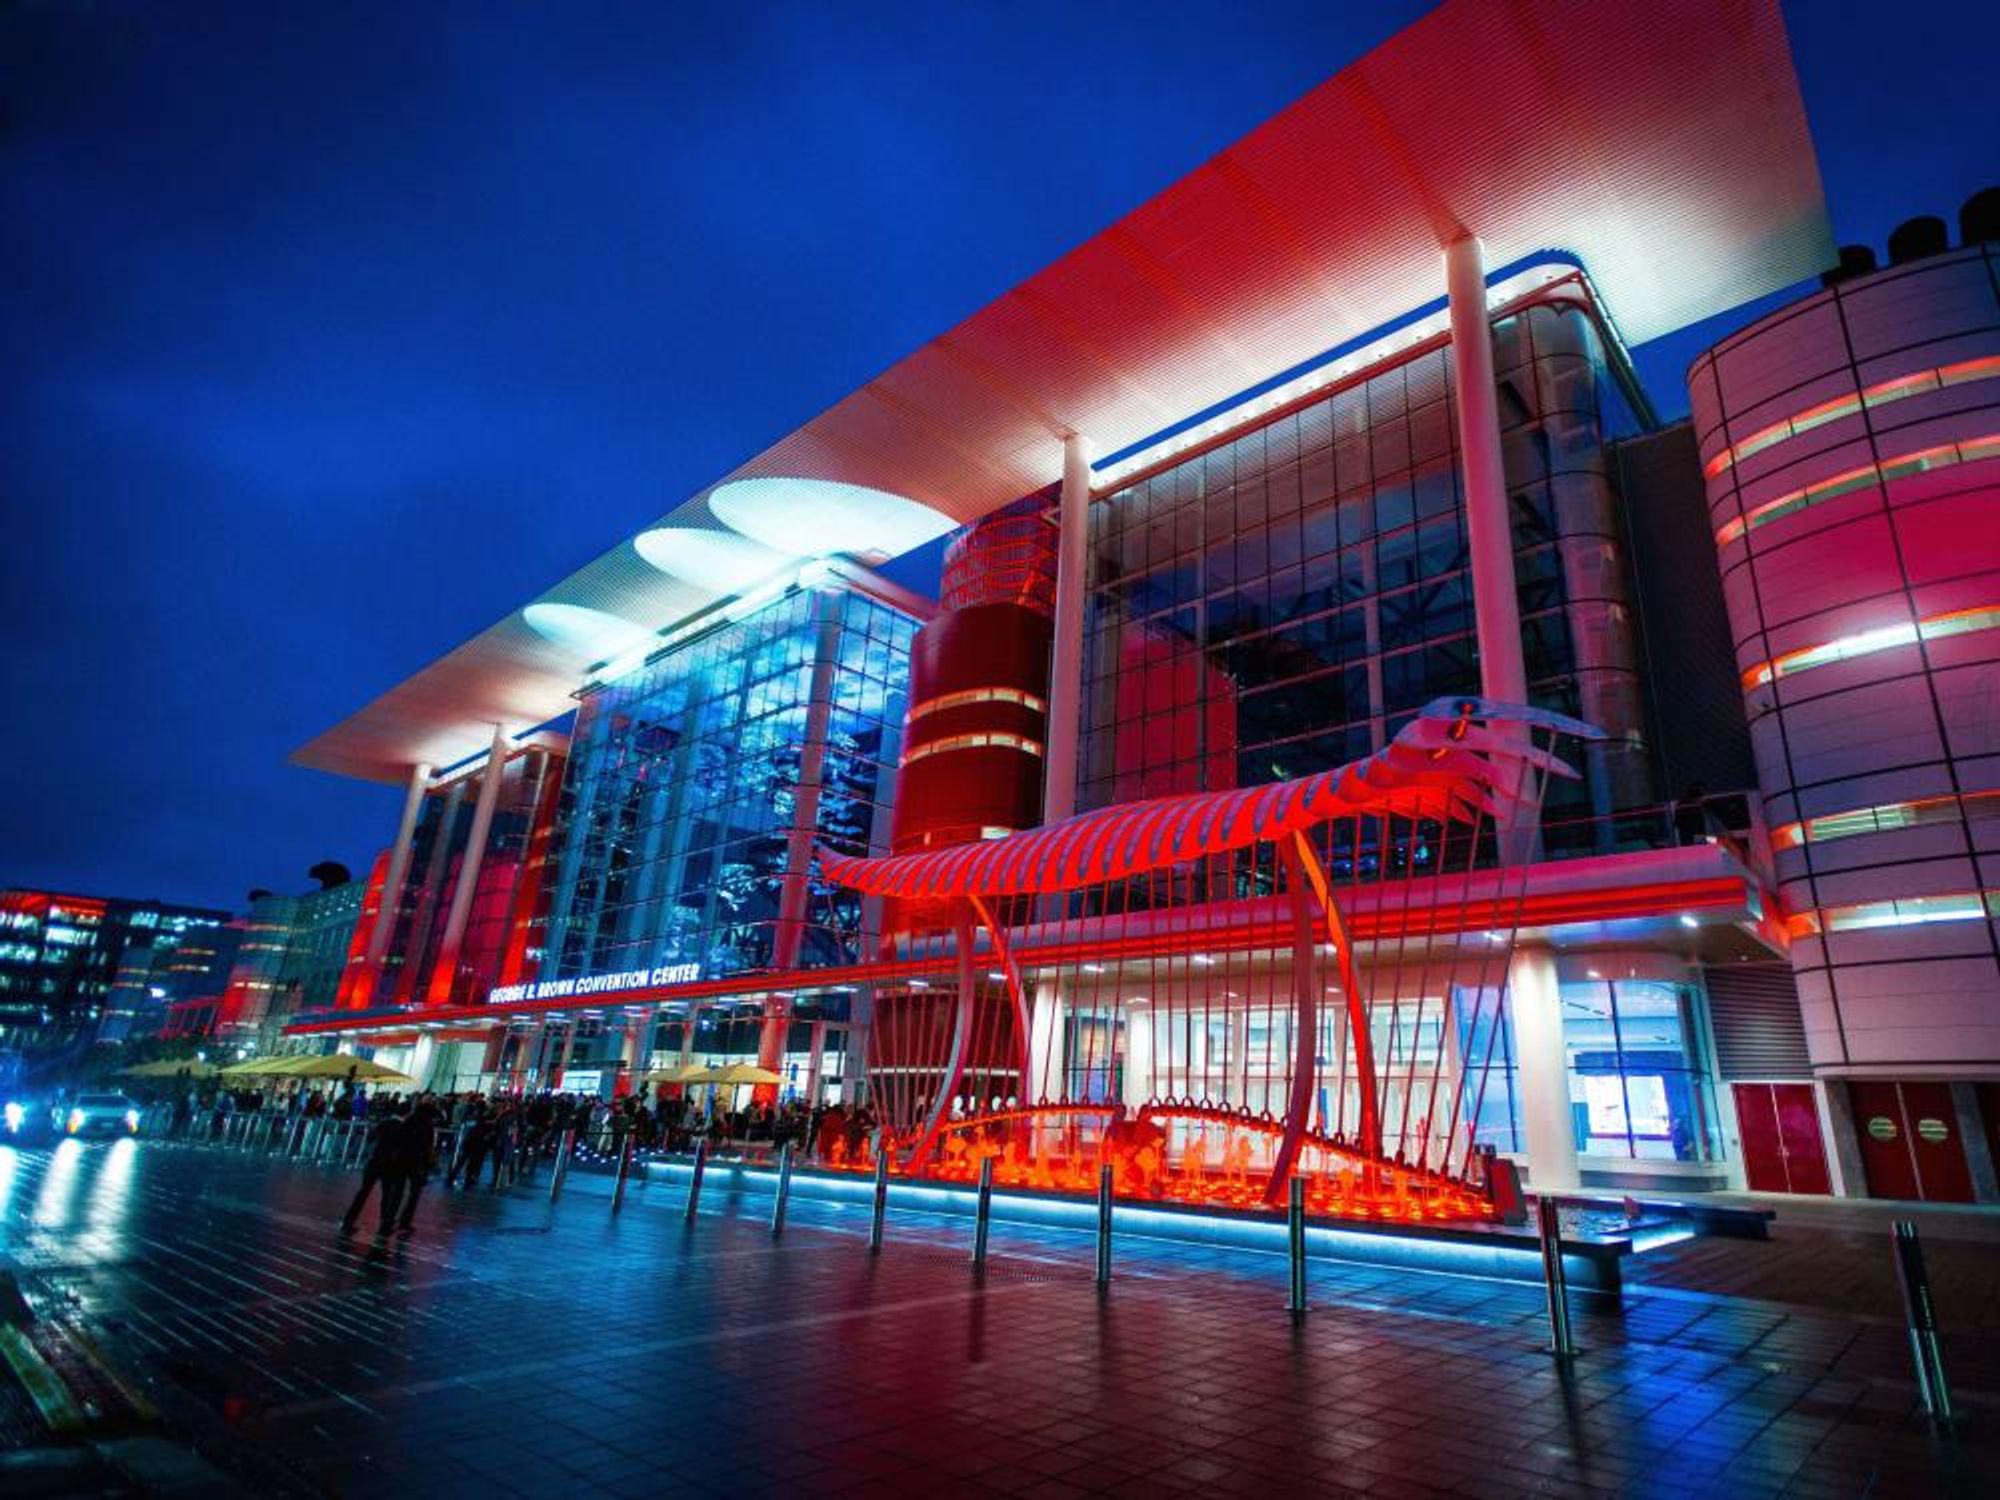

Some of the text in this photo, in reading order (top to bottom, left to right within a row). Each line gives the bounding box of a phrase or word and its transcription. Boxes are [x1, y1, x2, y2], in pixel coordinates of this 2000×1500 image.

[537, 979, 575, 998] BROWN
[576, 969, 649, 993] CONVENTION
[652, 962, 700, 985] CENTER
